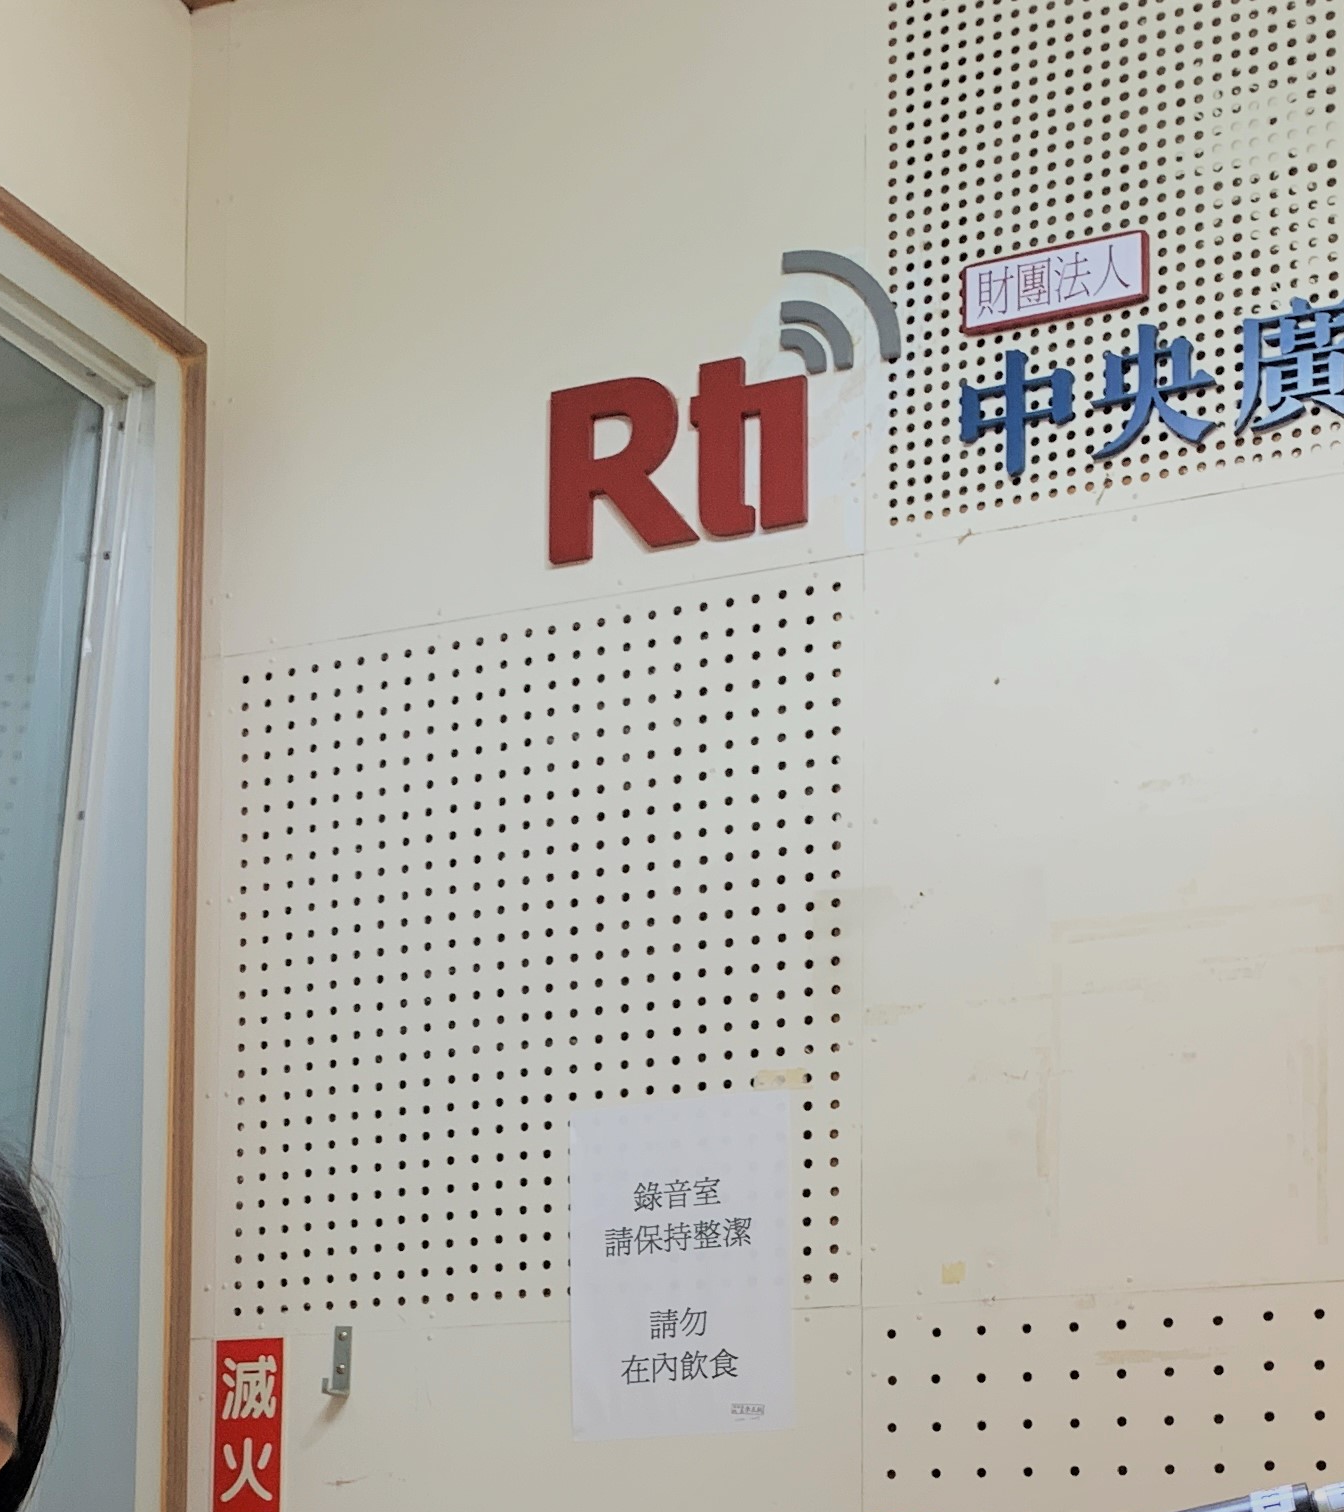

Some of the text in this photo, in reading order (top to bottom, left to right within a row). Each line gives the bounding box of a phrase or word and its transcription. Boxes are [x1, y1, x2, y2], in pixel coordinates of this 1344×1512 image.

[972, 238, 1134, 318] 財團法人
[634, 1177, 721, 1212] 錄音室
[605, 1217, 752, 1257] 請保持整潔
[650, 1307, 707, 1340] 請勿
[621, 1348, 739, 1385] 在內飲食
